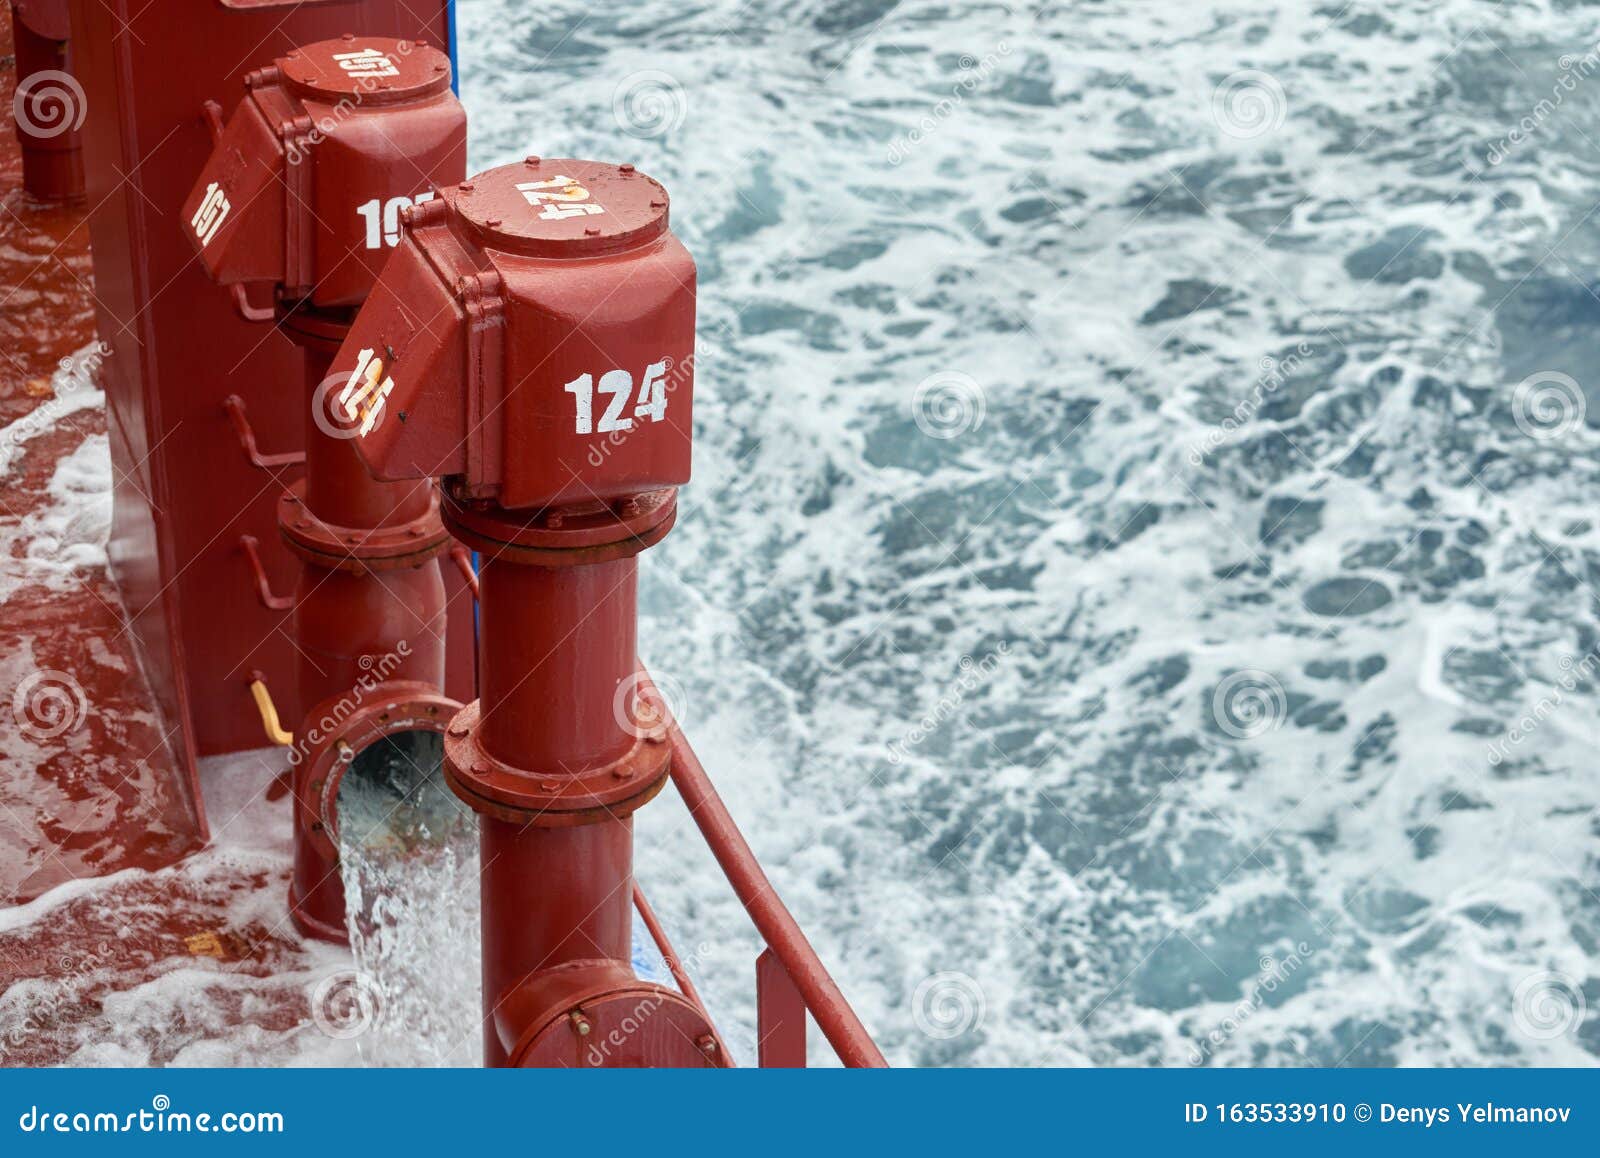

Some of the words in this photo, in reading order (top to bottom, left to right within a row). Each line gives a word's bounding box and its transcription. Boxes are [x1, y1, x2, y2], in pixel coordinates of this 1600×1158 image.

[356, 191, 435, 249] 10
[514, 175, 606, 220] 124
[339, 347, 395, 438] 124
[564, 360, 668, 434] 124
